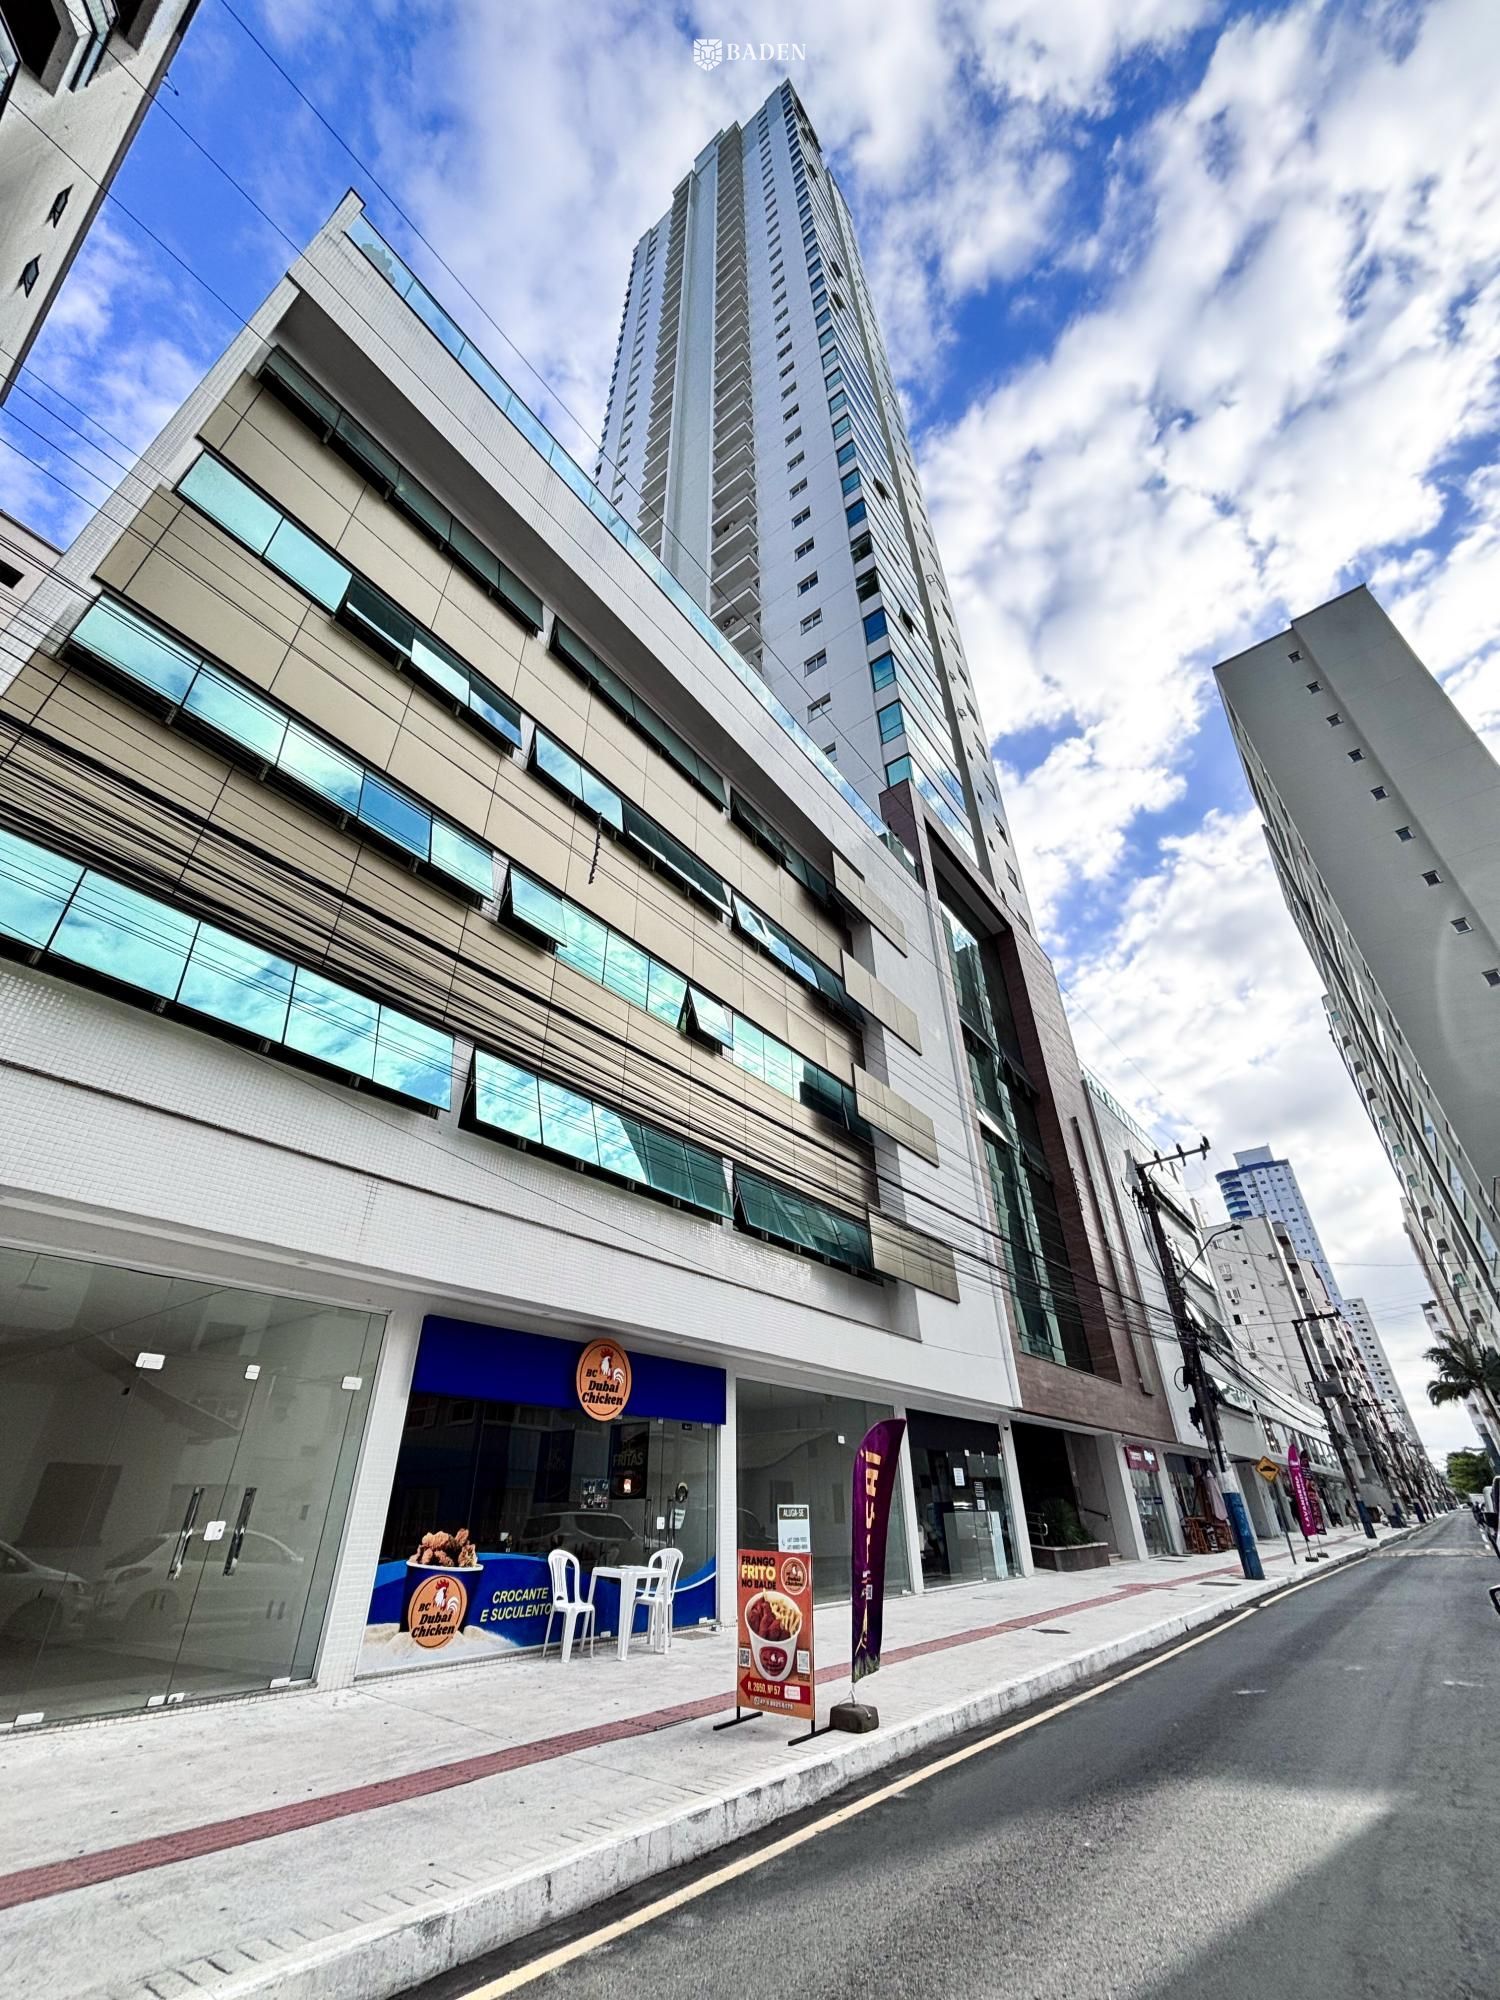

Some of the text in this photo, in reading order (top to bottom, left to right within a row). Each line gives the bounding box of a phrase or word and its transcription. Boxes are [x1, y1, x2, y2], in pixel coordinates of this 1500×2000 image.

[586, 1369, 598, 1377] BC
[588, 1381, 620, 1393] Dubai
[582, 1392, 623, 1405] Chicken
[613, 1453, 644, 1467] FRITAS
[783, 1508, 805, 1517] ALUGA-SE
[741, 1556, 775, 1567] FRANGO
[741, 1565, 776, 1581] FRITO
[741, 1579, 777, 1590] NO BALDE
[492, 1587, 549, 1604] CROCANTE
[418, 1603, 431, 1612] BC
[480, 1603, 553, 1623] E SUCULENTO
[419, 1611, 453, 1625] Dubai
[411, 1624, 455, 1638] Chicken
[774, 1685, 781, 1695] 57
